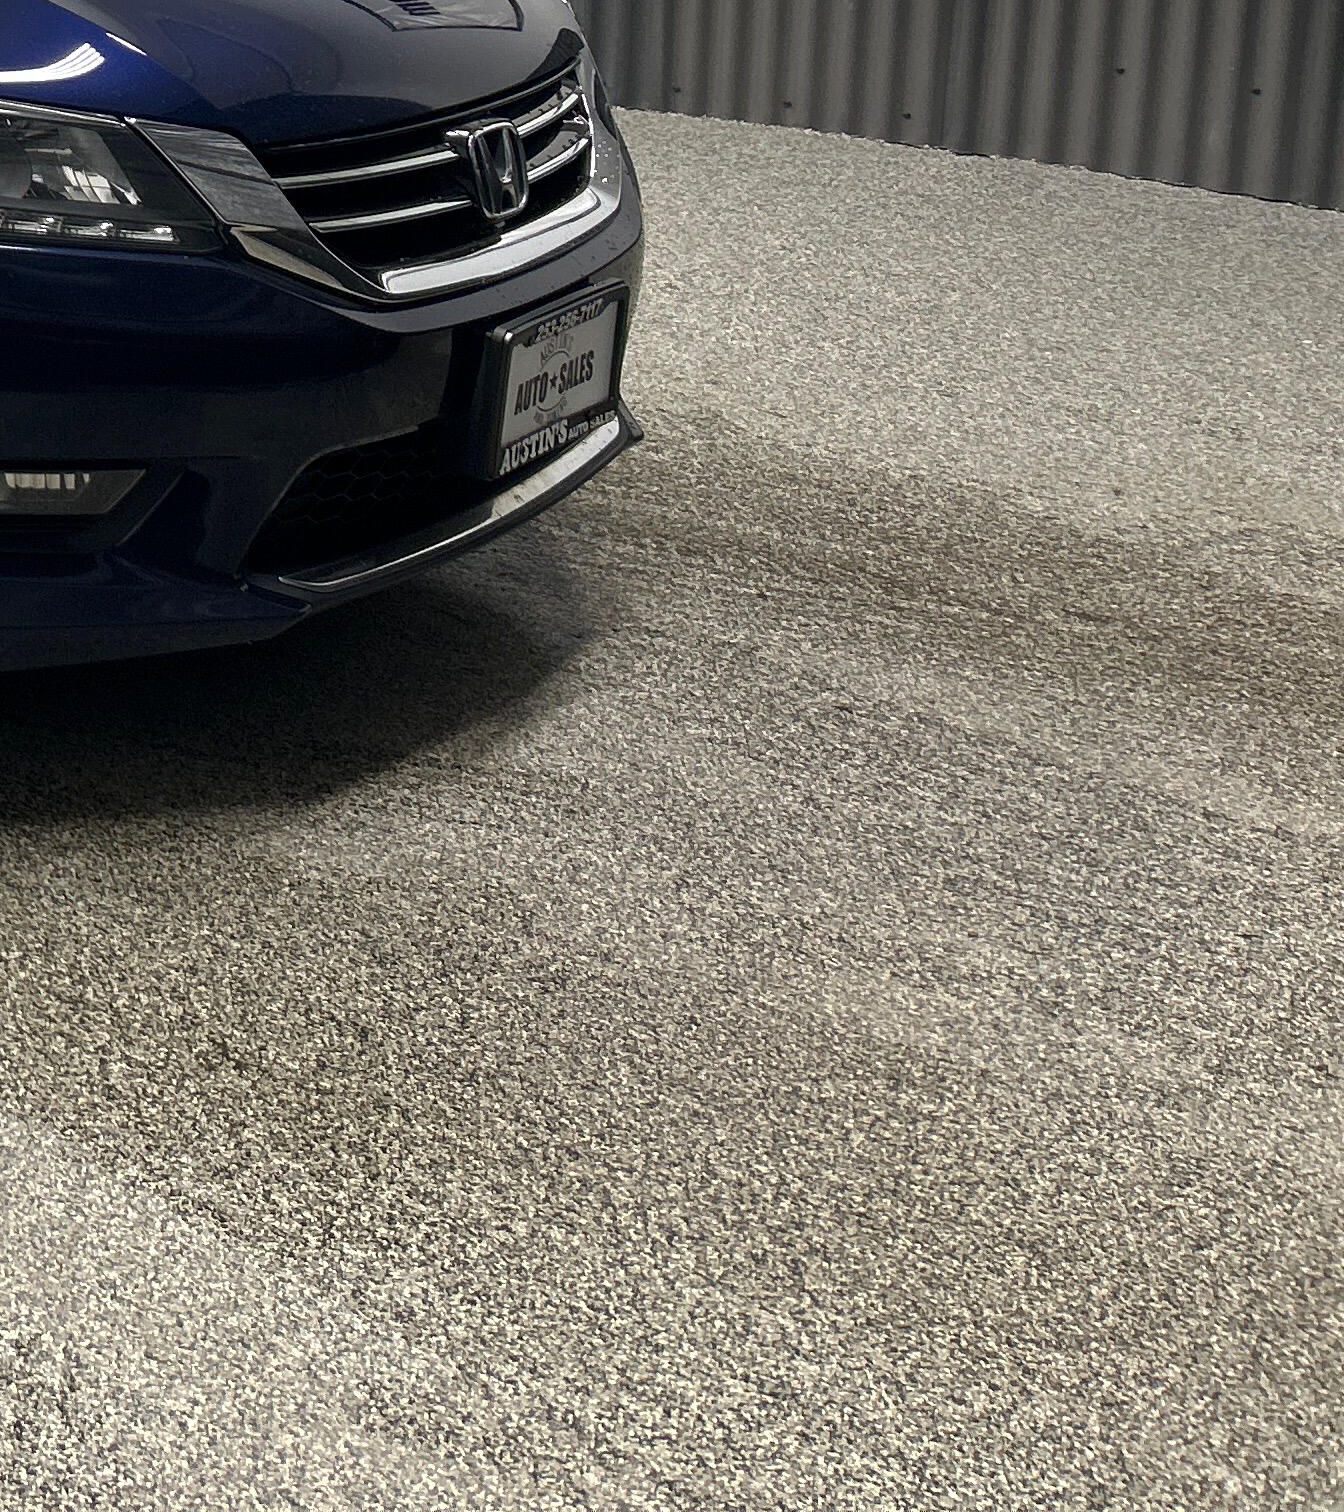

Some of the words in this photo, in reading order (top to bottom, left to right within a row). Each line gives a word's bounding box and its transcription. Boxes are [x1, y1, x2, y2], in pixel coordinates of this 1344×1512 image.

[514, 371, 549, 416] AUTO
[557, 349, 595, 395] SALES
[499, 418, 569, 476] AUSTIN'S
